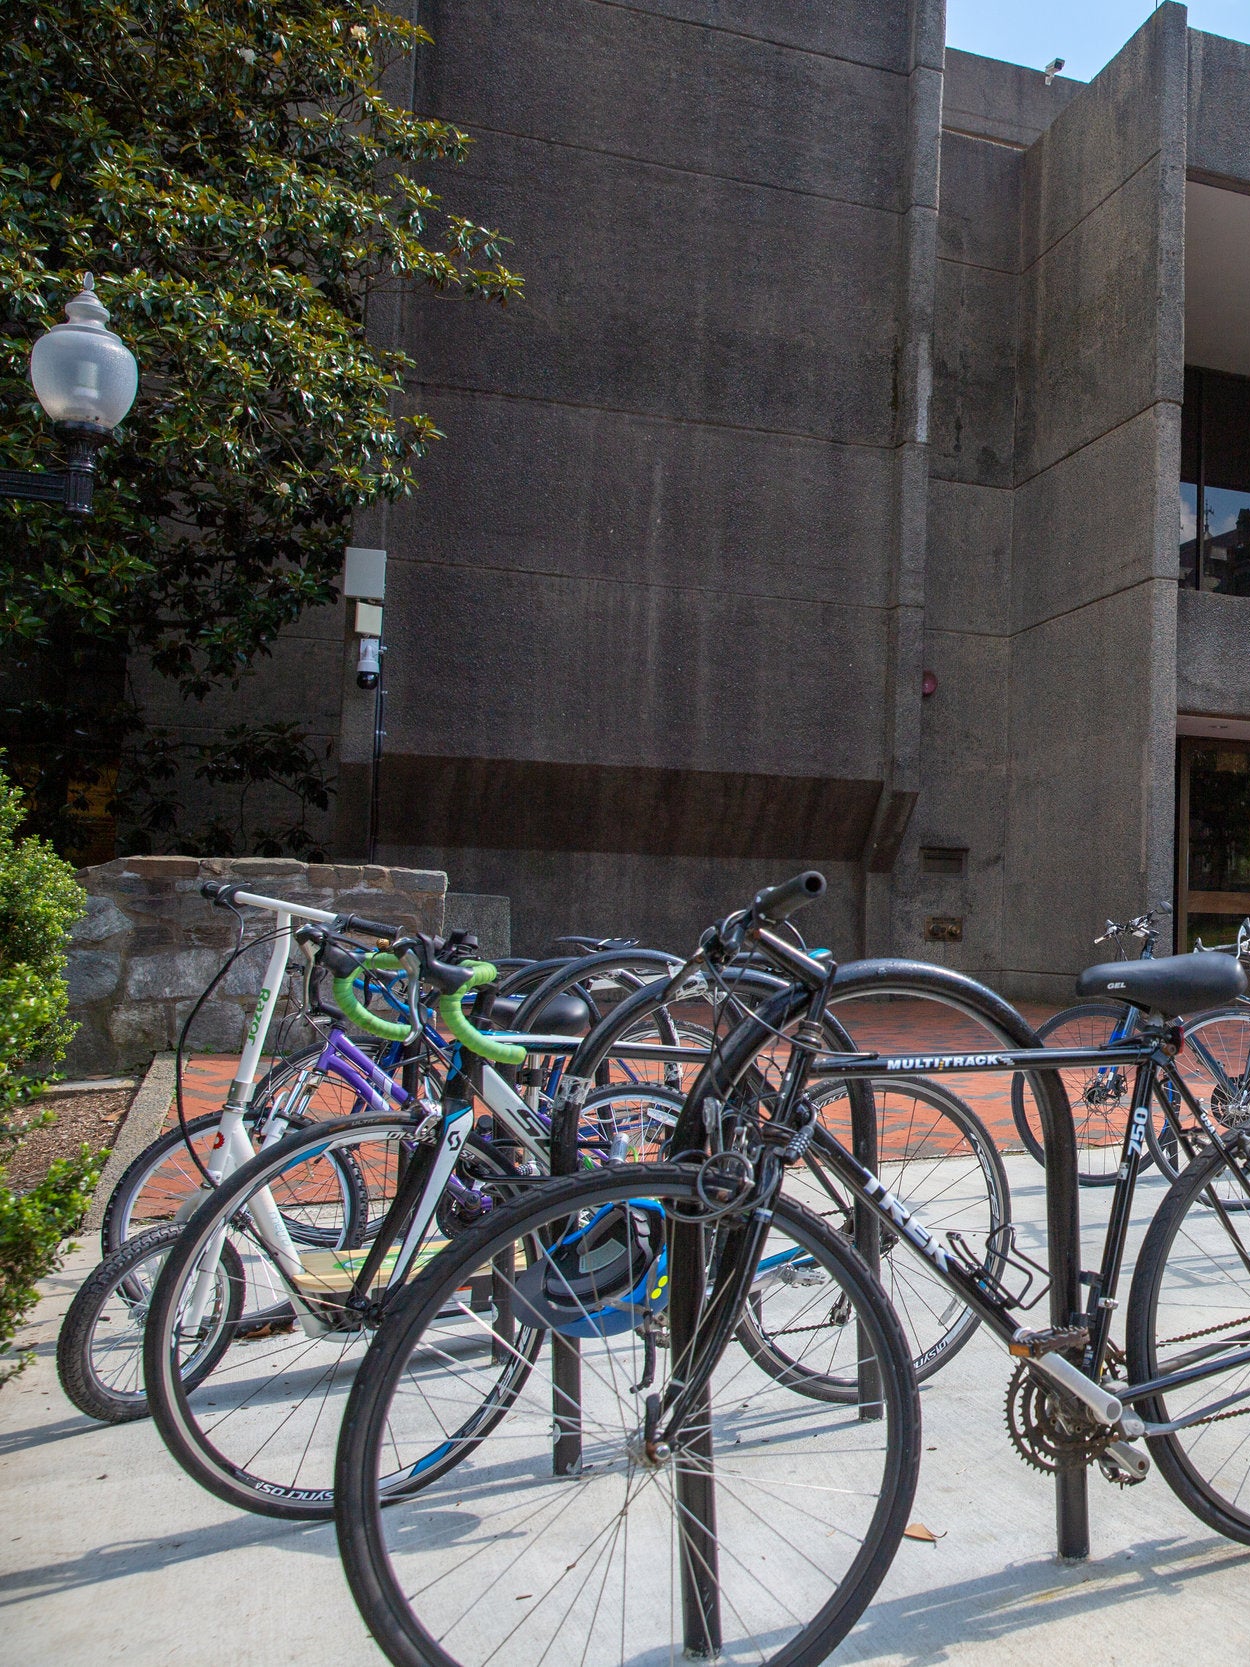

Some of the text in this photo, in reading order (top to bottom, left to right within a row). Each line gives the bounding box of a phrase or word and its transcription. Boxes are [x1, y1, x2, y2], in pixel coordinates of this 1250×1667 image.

[1106, 981, 1127, 990] GEL
[248, 988, 271, 1046] Razor
[1127, 1106, 1149, 1157] 750
[863, 1166, 956, 1273] TREK
